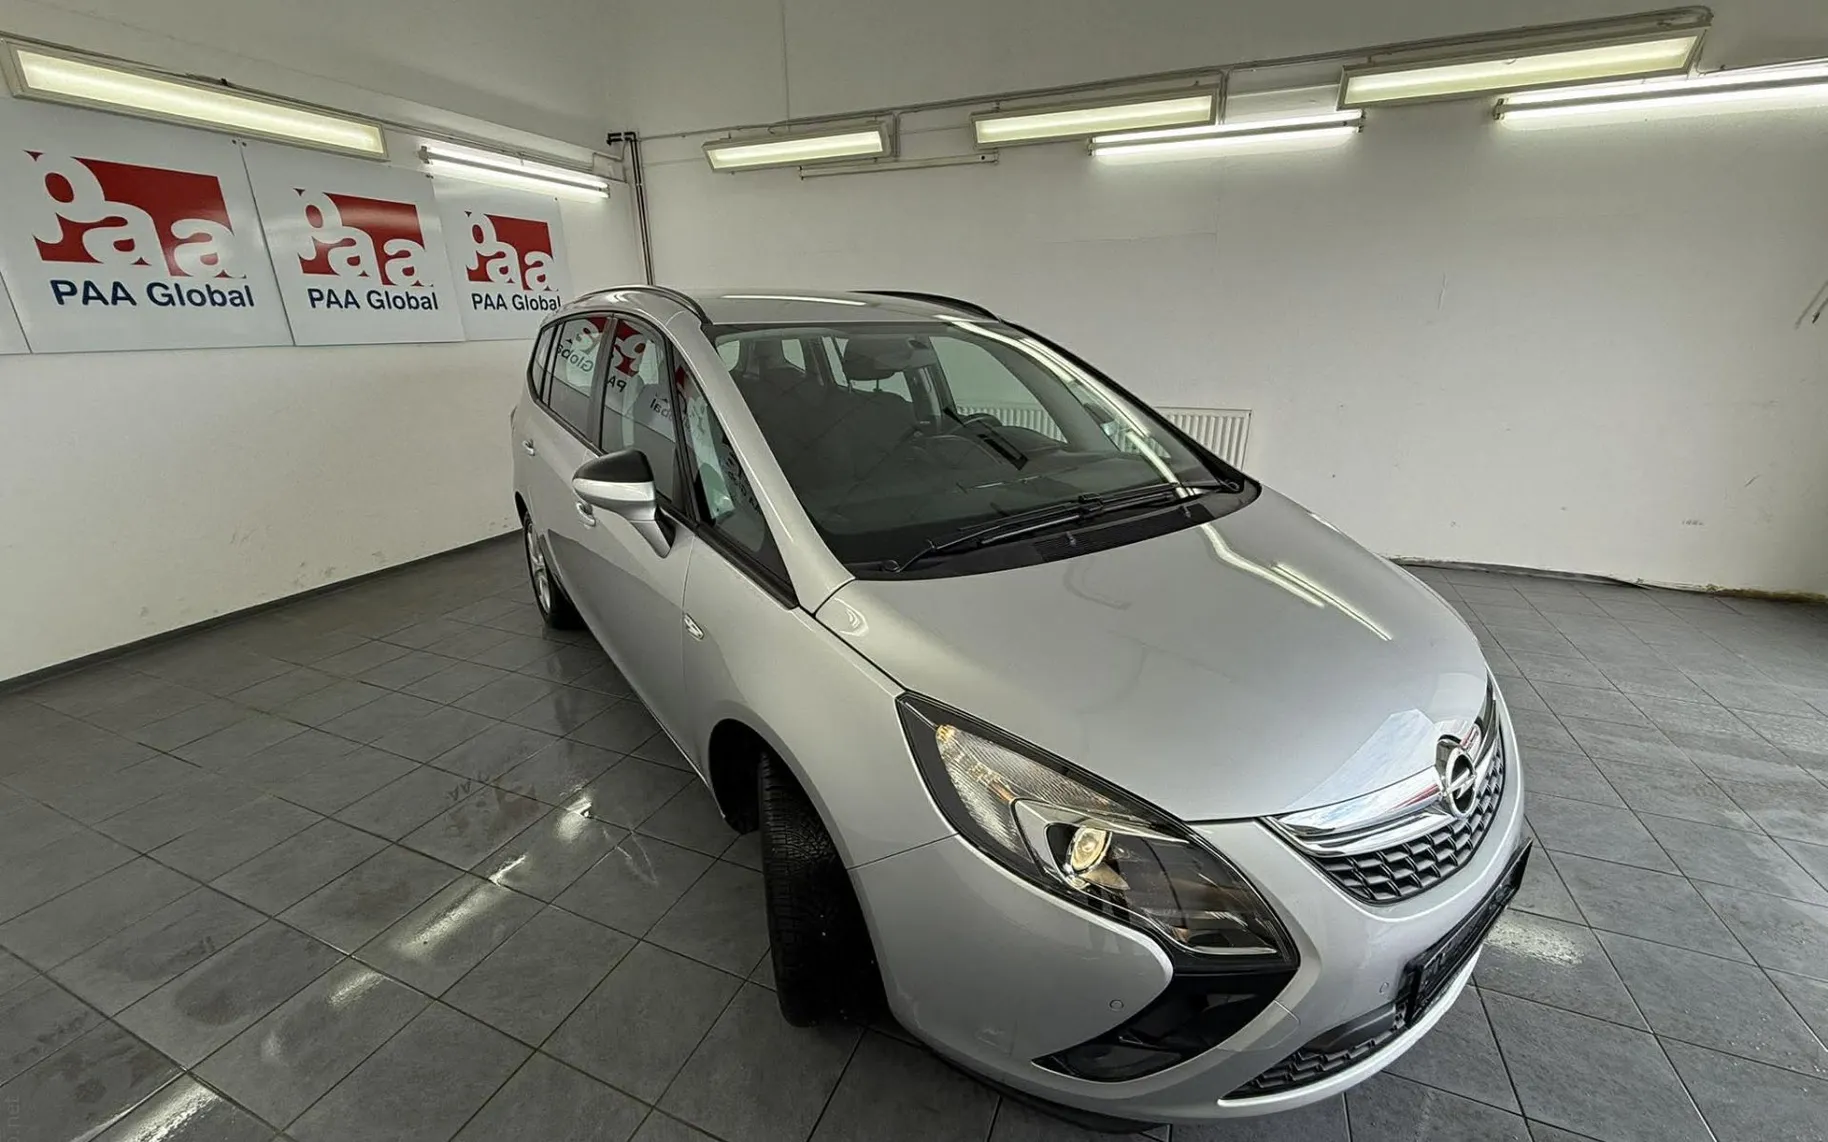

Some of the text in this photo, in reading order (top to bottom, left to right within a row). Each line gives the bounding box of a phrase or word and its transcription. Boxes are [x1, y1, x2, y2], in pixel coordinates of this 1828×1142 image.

[50, 280, 254, 307] PAA Global
[307, 288, 439, 310] PAA Global
[471, 292, 562, 312] PAA Global
